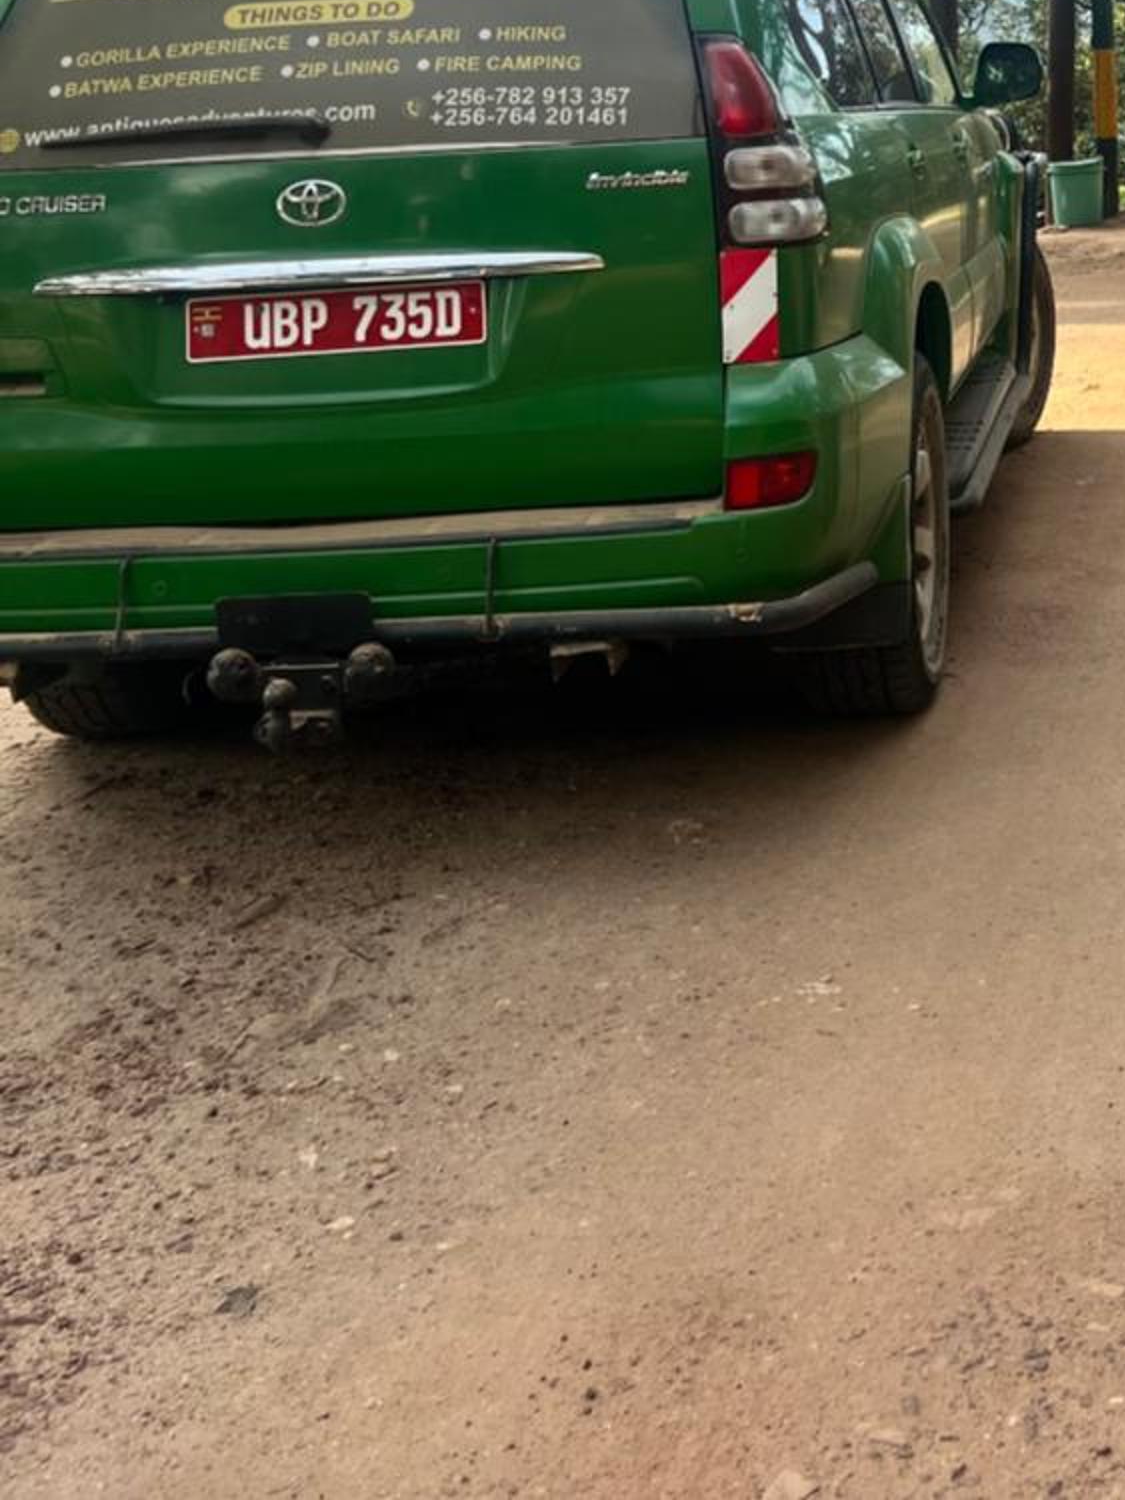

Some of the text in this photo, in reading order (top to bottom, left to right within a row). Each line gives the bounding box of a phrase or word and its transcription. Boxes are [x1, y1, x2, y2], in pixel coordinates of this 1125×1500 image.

[237, 1, 400, 24] THINGS TO DO
[326, 27, 460, 47] BOAT SAFARI
[497, 25, 566, 42] HIKING
[76, 35, 292, 67] GORILLA EXPERIENCE
[295, 58, 400, 79] ZIP LINING
[435, 54, 582, 72] FIRE CAMPING
[64, 65, 264, 98] BATWA EXPERIENCE
[432, 87, 630, 105] +256-782 913 357
[430, 106, 628, 126] +256-764 201461
[16, 193, 107, 215] CRUISER
[244, 289, 461, 349] UBP 735D
